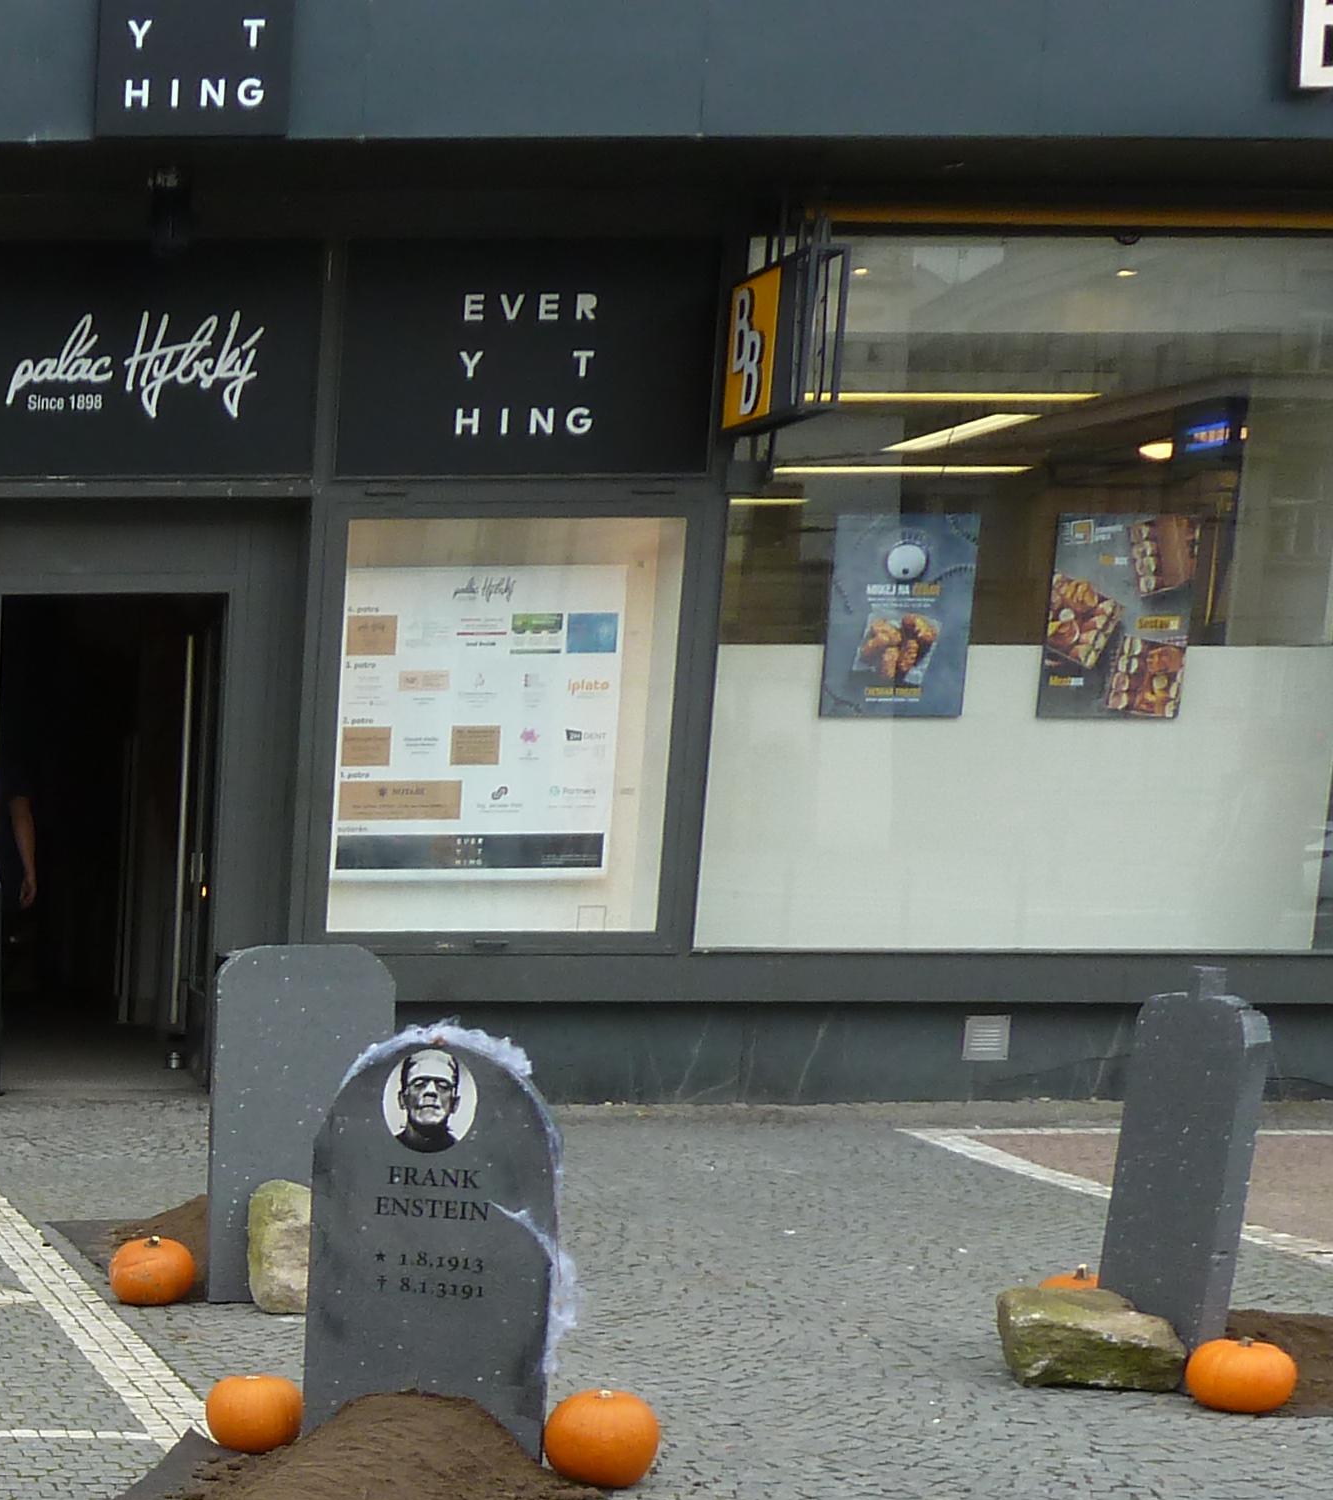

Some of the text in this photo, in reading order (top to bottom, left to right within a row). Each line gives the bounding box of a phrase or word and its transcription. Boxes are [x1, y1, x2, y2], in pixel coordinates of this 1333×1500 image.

[127, 18, 266, 49] Y T
[124, 77, 265, 109] HING
[464, 293, 597, 321] EVER
[5, 313, 114, 406] palác
[459, 350, 595, 378] Y T
[27, 392, 103, 411] Since 1898
[455, 407, 597, 435] HING
[386, 1165, 483, 1190] FRANK
[373, 1196, 491, 1222] ENSTEIN
